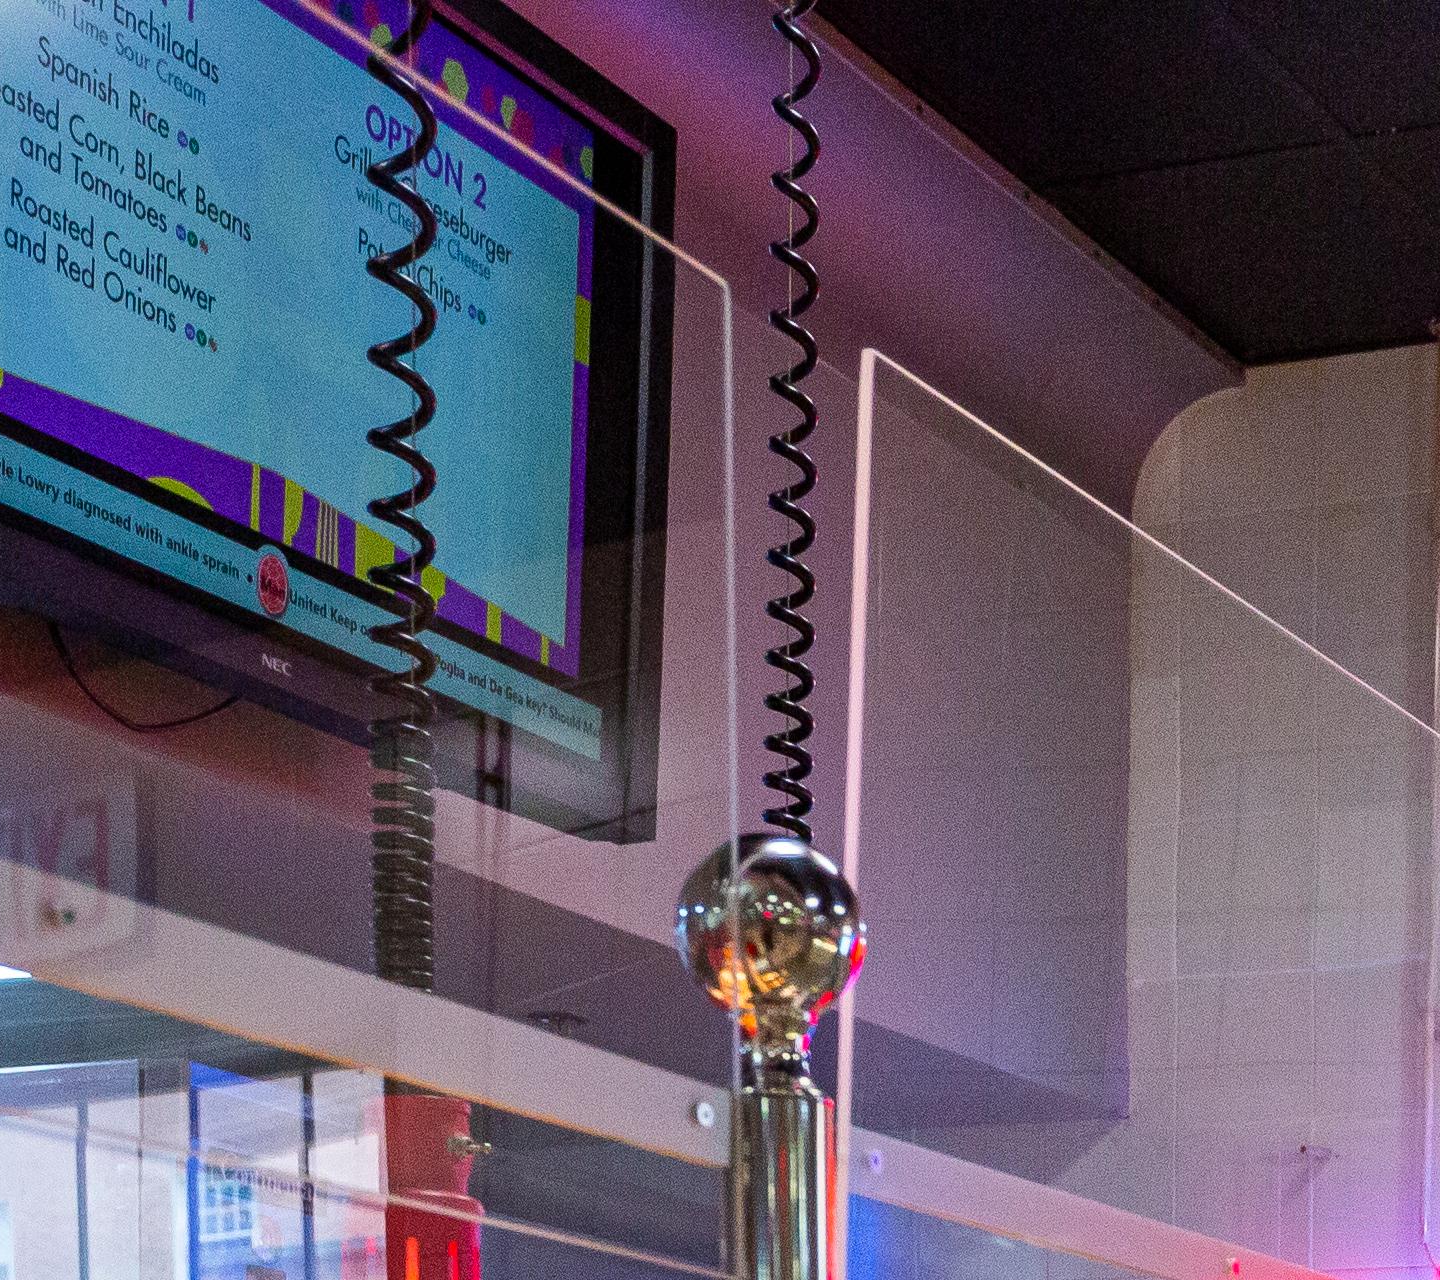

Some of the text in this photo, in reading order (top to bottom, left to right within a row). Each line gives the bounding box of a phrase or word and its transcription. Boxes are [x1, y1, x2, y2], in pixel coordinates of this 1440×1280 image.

[38, 36, 170, 139] Spanish Rice
[73, 7, 109, 47] Lime
[115, 32, 151, 71] Sour
[155, 60, 207, 106] Cream
[113, 0, 220, 84] Enchiladas
[20, 134, 168, 233] and Tomatoes
[69, 114, 124, 174] Corn,
[134, 149, 187, 206] Black
[195, 184, 252, 242] Beans
[365, 104, 487, 211] OPTON 2
[4, 227, 177, 333] and Red Onions
[11, 177, 94, 249] Roasted
[103, 231, 217, 313] Cauliflower
[355, 186, 383, 215] with
[448, 239, 491, 280] Cheese
[417, 266, 462, 313] Chips
[18, 465, 60, 500] Lowry
[63, 487, 131, 533] diagnosed
[135, 520, 162, 546] with
[166, 530, 200, 560] ankle
[202, 551, 241, 580] sprain
[289, 589, 327, 618] United
[330, 606, 359, 635] Keep
[467, 671, 487, 690] and
[261, 652, 292, 677] NEC
